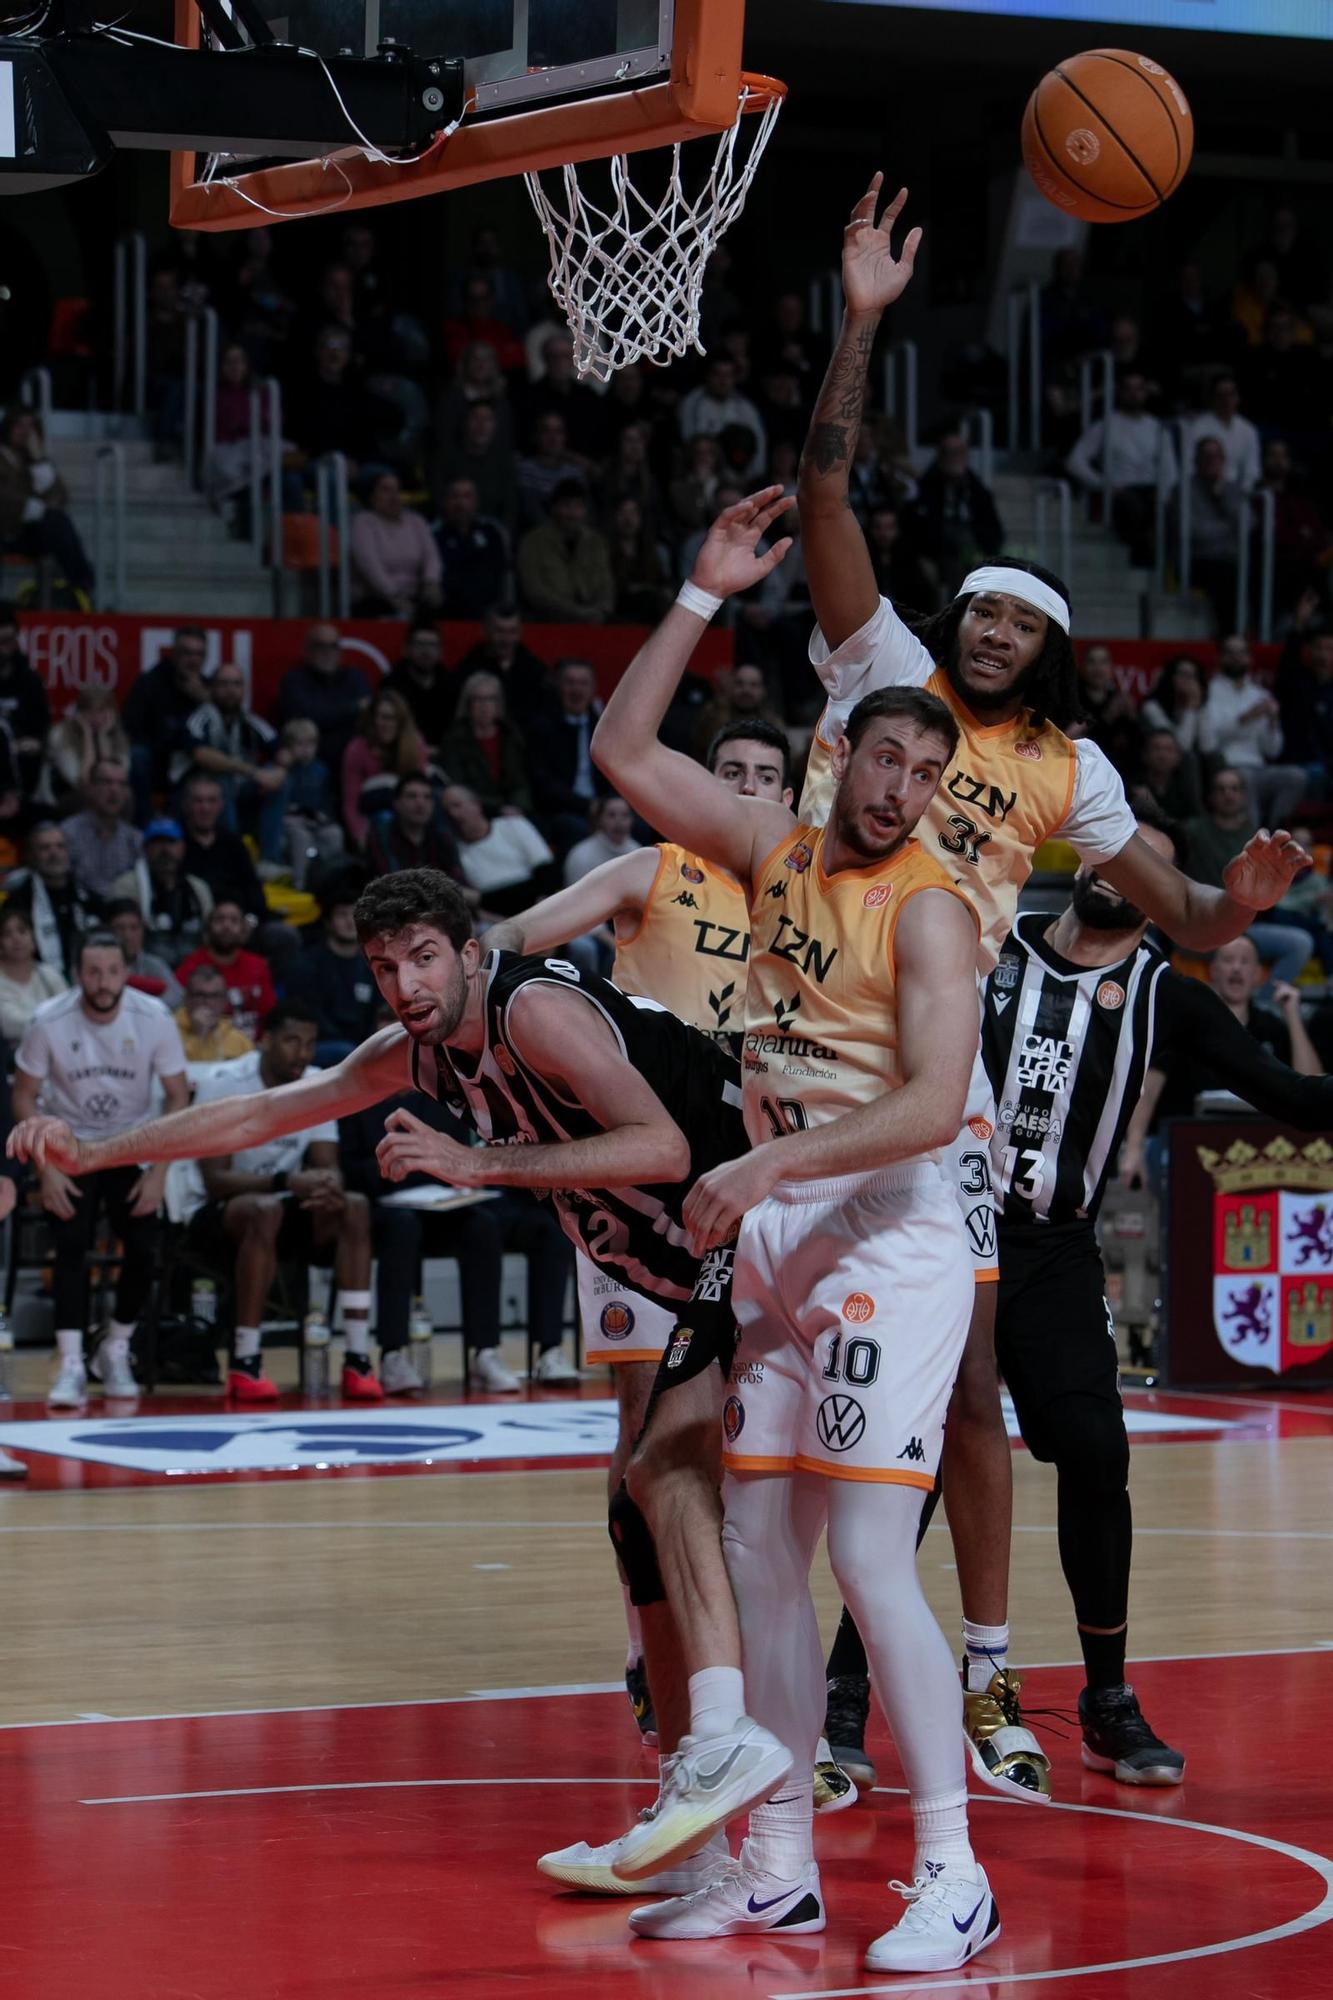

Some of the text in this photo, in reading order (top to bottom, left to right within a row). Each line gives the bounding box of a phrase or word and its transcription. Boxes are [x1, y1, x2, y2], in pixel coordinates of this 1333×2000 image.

[939, 814, 992, 867] 31
[782, 1064, 837, 1080] Fundación
[760, 1096, 809, 1139] 10
[1000, 1109, 1061, 1136] CAESA
[1004, 1100, 1049, 1117] GRUPO
[999, 1145, 1047, 1200] 13
[821, 1332, 881, 1388] 10
